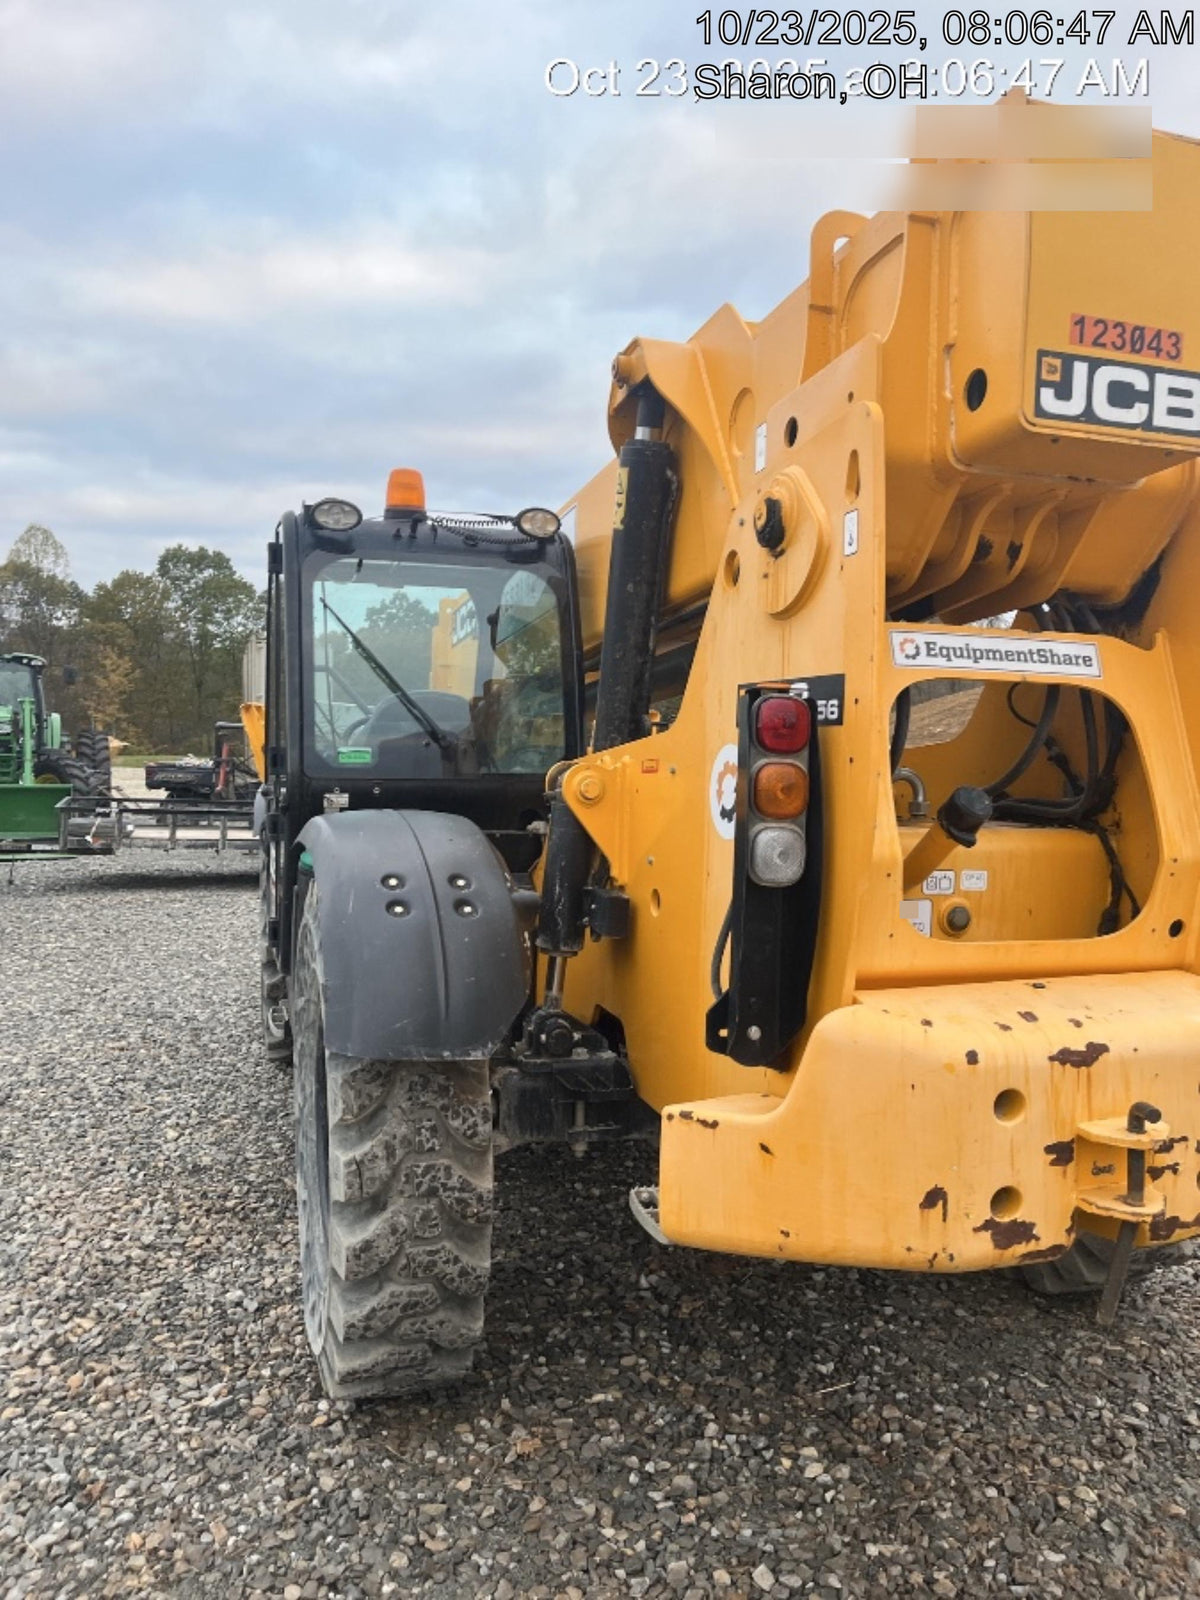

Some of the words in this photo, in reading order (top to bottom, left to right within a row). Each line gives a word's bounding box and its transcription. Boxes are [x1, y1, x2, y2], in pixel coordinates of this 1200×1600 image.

[1073, 315, 1182, 361] 123043
[1039, 360, 1200, 431] JCB
[924, 641, 1094, 668] EquipmentShare
